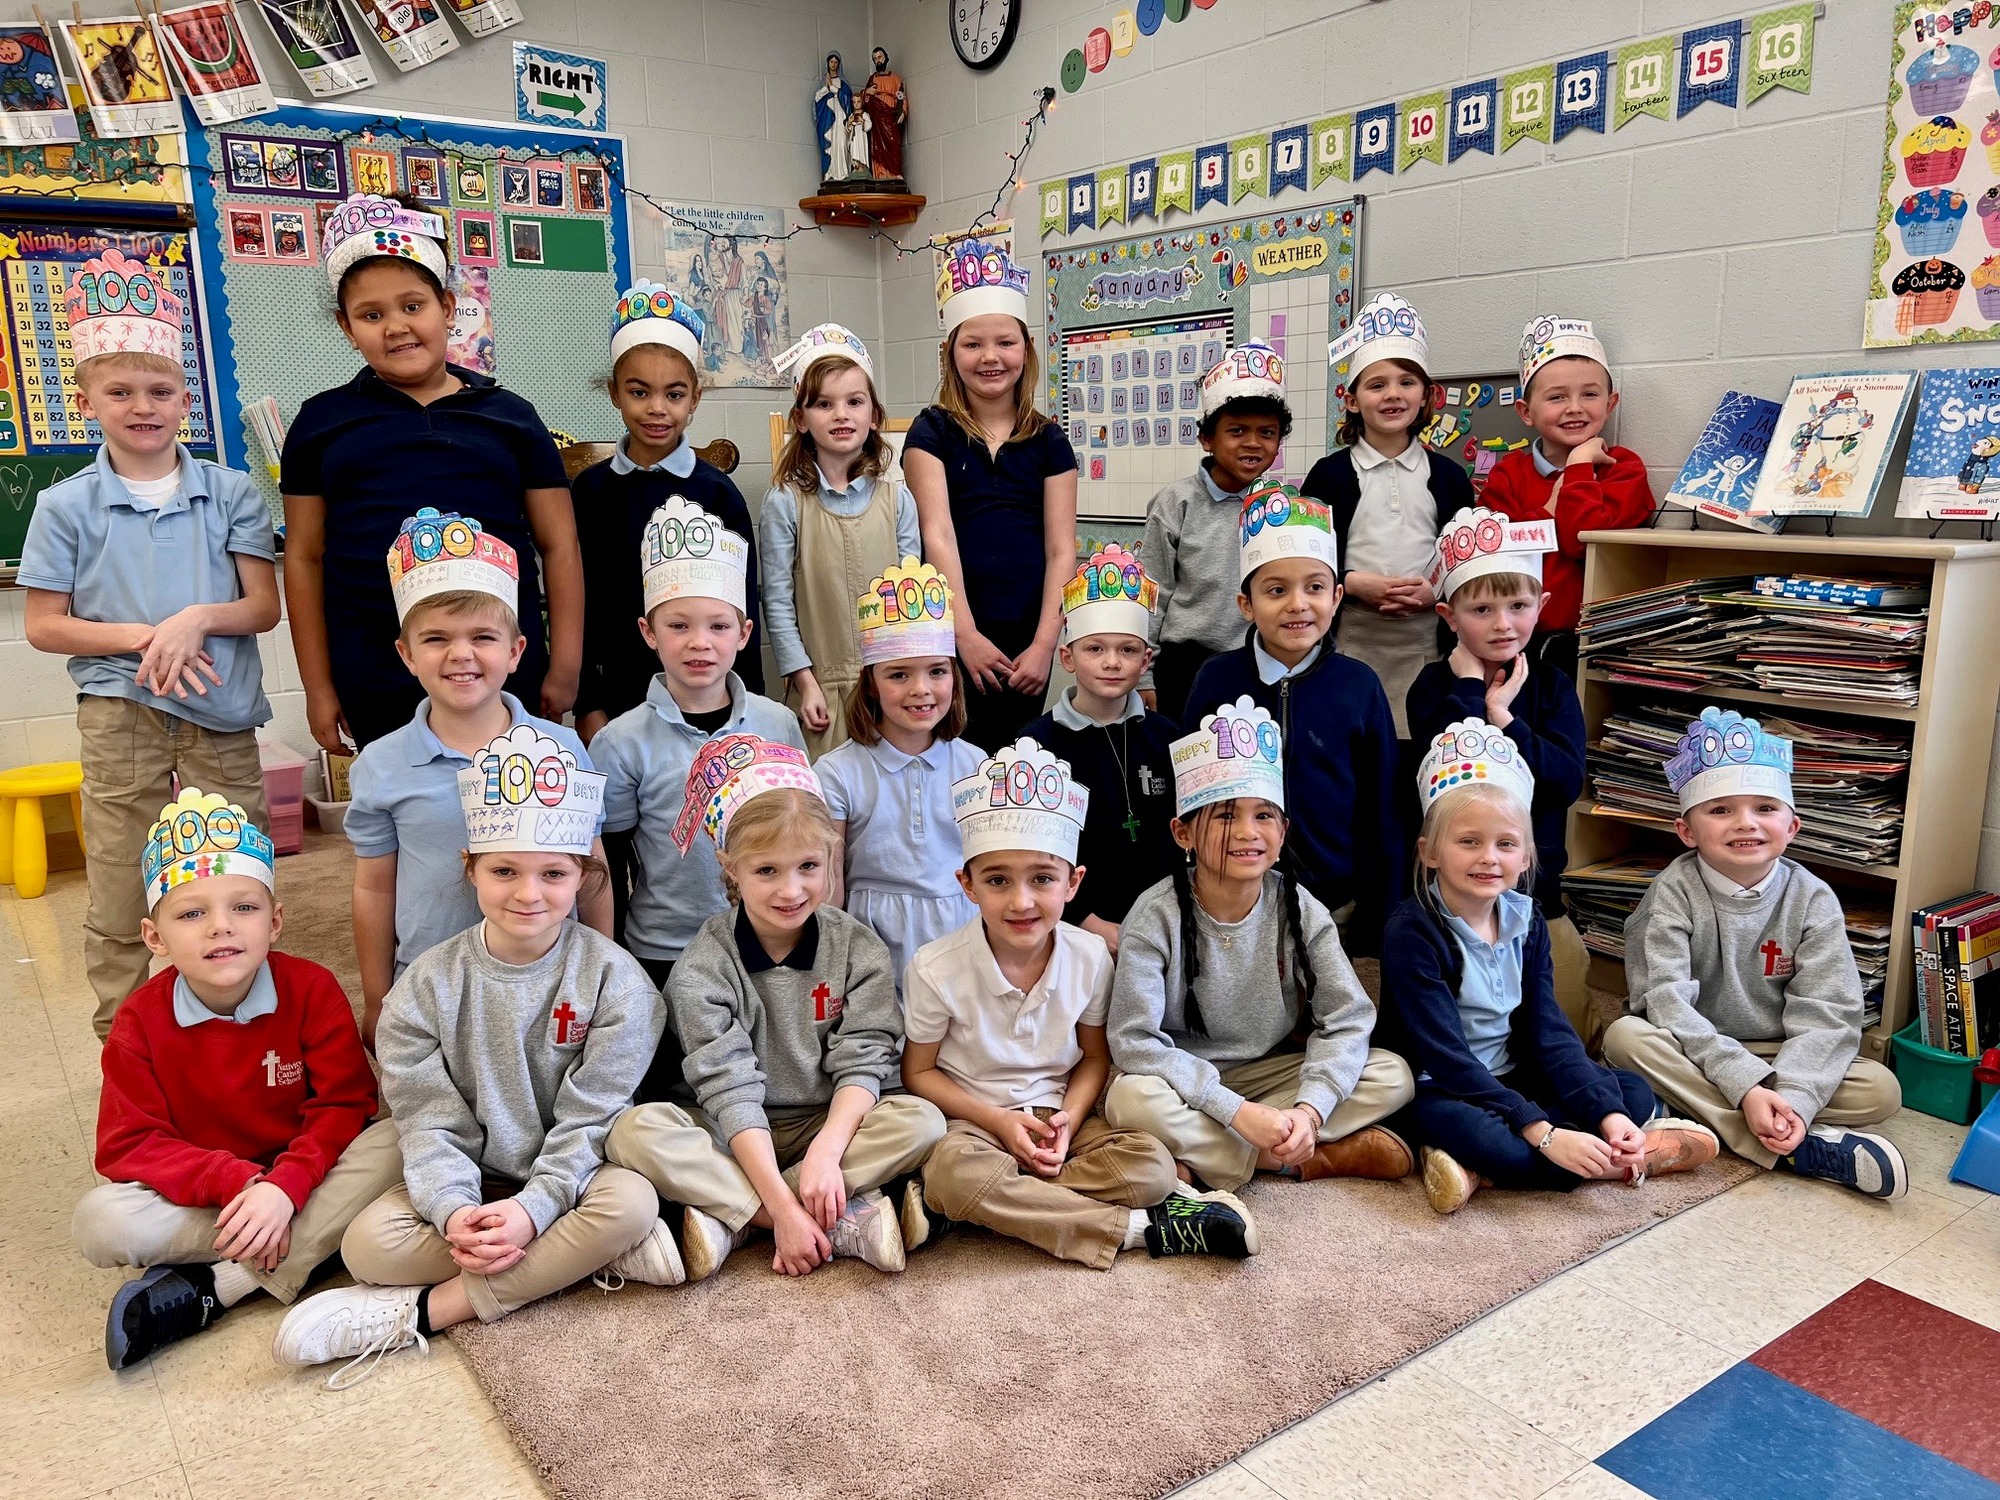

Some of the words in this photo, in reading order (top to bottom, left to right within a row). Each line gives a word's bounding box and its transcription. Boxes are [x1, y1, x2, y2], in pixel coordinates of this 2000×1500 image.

[958, 9, 966, 22] 9
[999, 14, 1007, 27] 4
[1141, 4, 1155, 28] 3
[962, 28, 970, 41] 8
[991, 32, 999, 46] 5
[980, 42, 988, 55] 6
[1764, 31, 1796, 62] 16
[1695, 48, 1724, 77] 15
[528, 63, 594, 94] RIGHT
[1629, 61, 1657, 90] 14
[1757, 67, 1810, 86] sixteen
[1567, 77, 1592, 103] 13
[1687, 83, 1731, 99] fifteen
[1515, 88, 1539, 114] 12
[1622, 94, 1670, 115] fourteen
[1462, 102, 1481, 127] 11
[1411, 114, 1433, 138] 10
[1507, 121, 1544, 138] twelve
[1368, 125, 1380, 147] 9
[1456, 133, 1492, 148] eleven
[1325, 134, 1337, 156] 8
[1918, 136, 1948, 151] April
[1284, 144, 1294, 164] 7
[1409, 144, 1433, 158] ten
[1244, 153, 1254, 172] 6
[1319, 162, 1343, 176] eight
[1207, 161, 1216, 180] 5
[1169, 168, 1179, 187] 4
[1107, 182, 1115, 200] 2
[1138, 176, 1145, 194] 3
[1049, 194, 1058, 213] 0
[1078, 190, 1085, 207] 1
[1162, 195, 1184, 204] four
[687, 207, 702, 217] the
[703, 208, 725, 219] little
[726, 210, 764, 222] children
[1102, 207, 1119, 219] two
[1919, 203, 1941, 219] July
[16, 230, 109, 253] Numbers
[115, 233, 166, 257] 1-100
[1257, 242, 1323, 268] WEATHER
[173, 270, 184, 281] 10
[1910, 275, 1947, 288] October
[16, 283, 24, 294] 11
[33, 284, 45, 294] 12
[52, 284, 63, 295] 13
[1097, 271, 1183, 299] January
[174, 289, 188, 299] 20
[16, 302, 28, 312] 21
[34, 302, 49, 313] 22
[53, 303, 66, 313] 23
[20, 321, 31, 331] 31
[37, 321, 51, 331] 32
[56, 321, 70, 331] 33
[22, 339, 34, 349] 41
[39, 339, 54, 349] 42
[58, 339, 73, 350] 43
[181, 342, 195, 352] 50
[1330, 331, 1360, 358] HAPPY
[25, 357, 36, 367] 51
[42, 358, 57, 368] 52
[61, 358, 75, 368] 53
[183, 359, 197, 369] 60
[27, 376, 39, 386] 61
[44, 375, 59, 386] 62
[63, 376, 78, 386] 63
[186, 376, 199, 386] 70
[1204, 364, 1233, 390] HAPPY
[1968, 377, 2000, 390] WIN
[1183, 388, 1194, 401] 13
[1464, 382, 1495, 408] 99
[1793, 387, 1806, 395] All
[1805, 386, 1820, 394] You
[1820, 384, 1842, 393] Need
[1843, 383, 1855, 392] for
[1863, 382, 1904, 391] Snowman
[30, 394, 42, 404] 71
[47, 394, 62, 404] 72
[1114, 395, 1124, 407] 10
[1135, 392, 1144, 405] 11
[1160, 391, 1170, 404] 12
[33, 412, 44, 422] 81
[50, 412, 65, 422] 82
[69, 412, 83, 422] 83
[189, 411, 204, 421] 90
[1459, 408, 1473, 434] 5
[1939, 396, 2000, 433] SNO
[1157, 425, 1167, 438] 19
[1181, 424, 1192, 437] 20
[1748, 415, 1776, 435] JAC
[36, 430, 47, 440] 91
[52, 430, 67, 440] 92
[71, 430, 86, 440] 93
[88, 429, 103, 439] 94
[190, 429, 207, 439] 100
[1073, 426, 1083, 439] 15
[1116, 426, 1124, 439] 17
[1136, 425, 1146, 439] 18
[1462, 435, 1478, 460] 6
[1736, 432, 1771, 454] FROS
[1084, 561, 1141, 601] 100
[1172, 739, 1213, 765] HAPPY
[573, 781, 600, 801] DAY!
[953, 785, 987, 810] HAPPY
[1943, 967, 1959, 1010] SPACE
